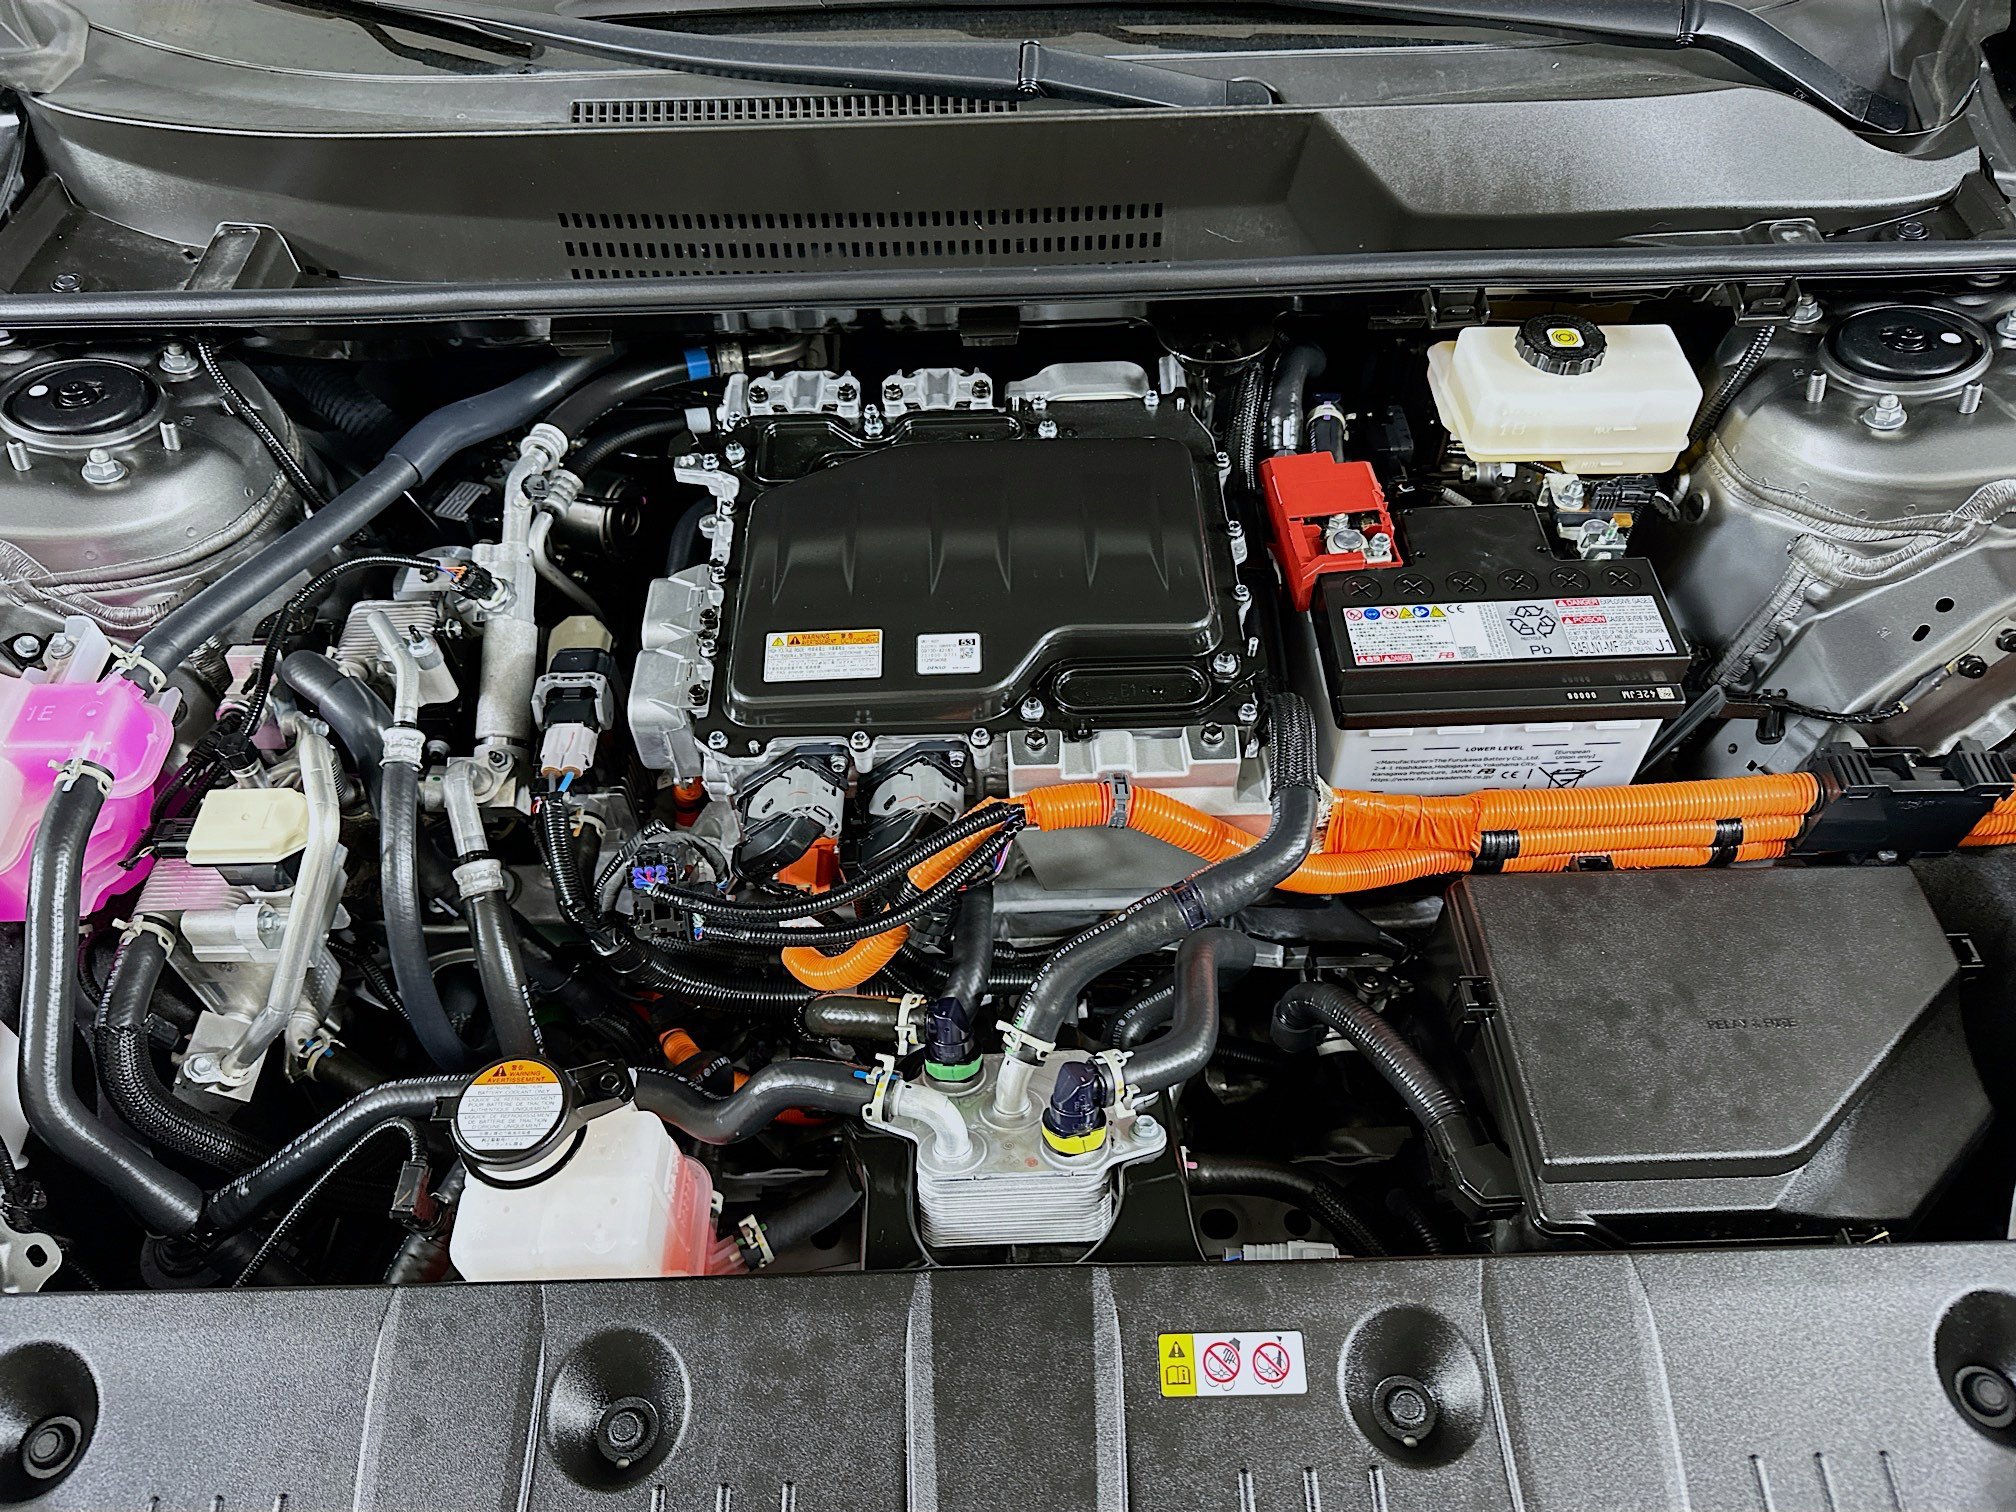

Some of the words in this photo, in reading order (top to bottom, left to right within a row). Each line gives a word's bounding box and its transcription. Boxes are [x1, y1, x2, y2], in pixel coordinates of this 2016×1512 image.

[1594, 426, 1613, 435] MAX
[1573, 616, 1606, 624] POISON
[1530, 645, 1553, 655] Pb
[1501, 771, 1519, 780] CE
[1076, 929, 1100, 944] WATER
[1707, 1019, 1747, 1029] RELAY
[1751, 1019, 1761, 1029] &
[1763, 1018, 1797, 1028] FUSE
